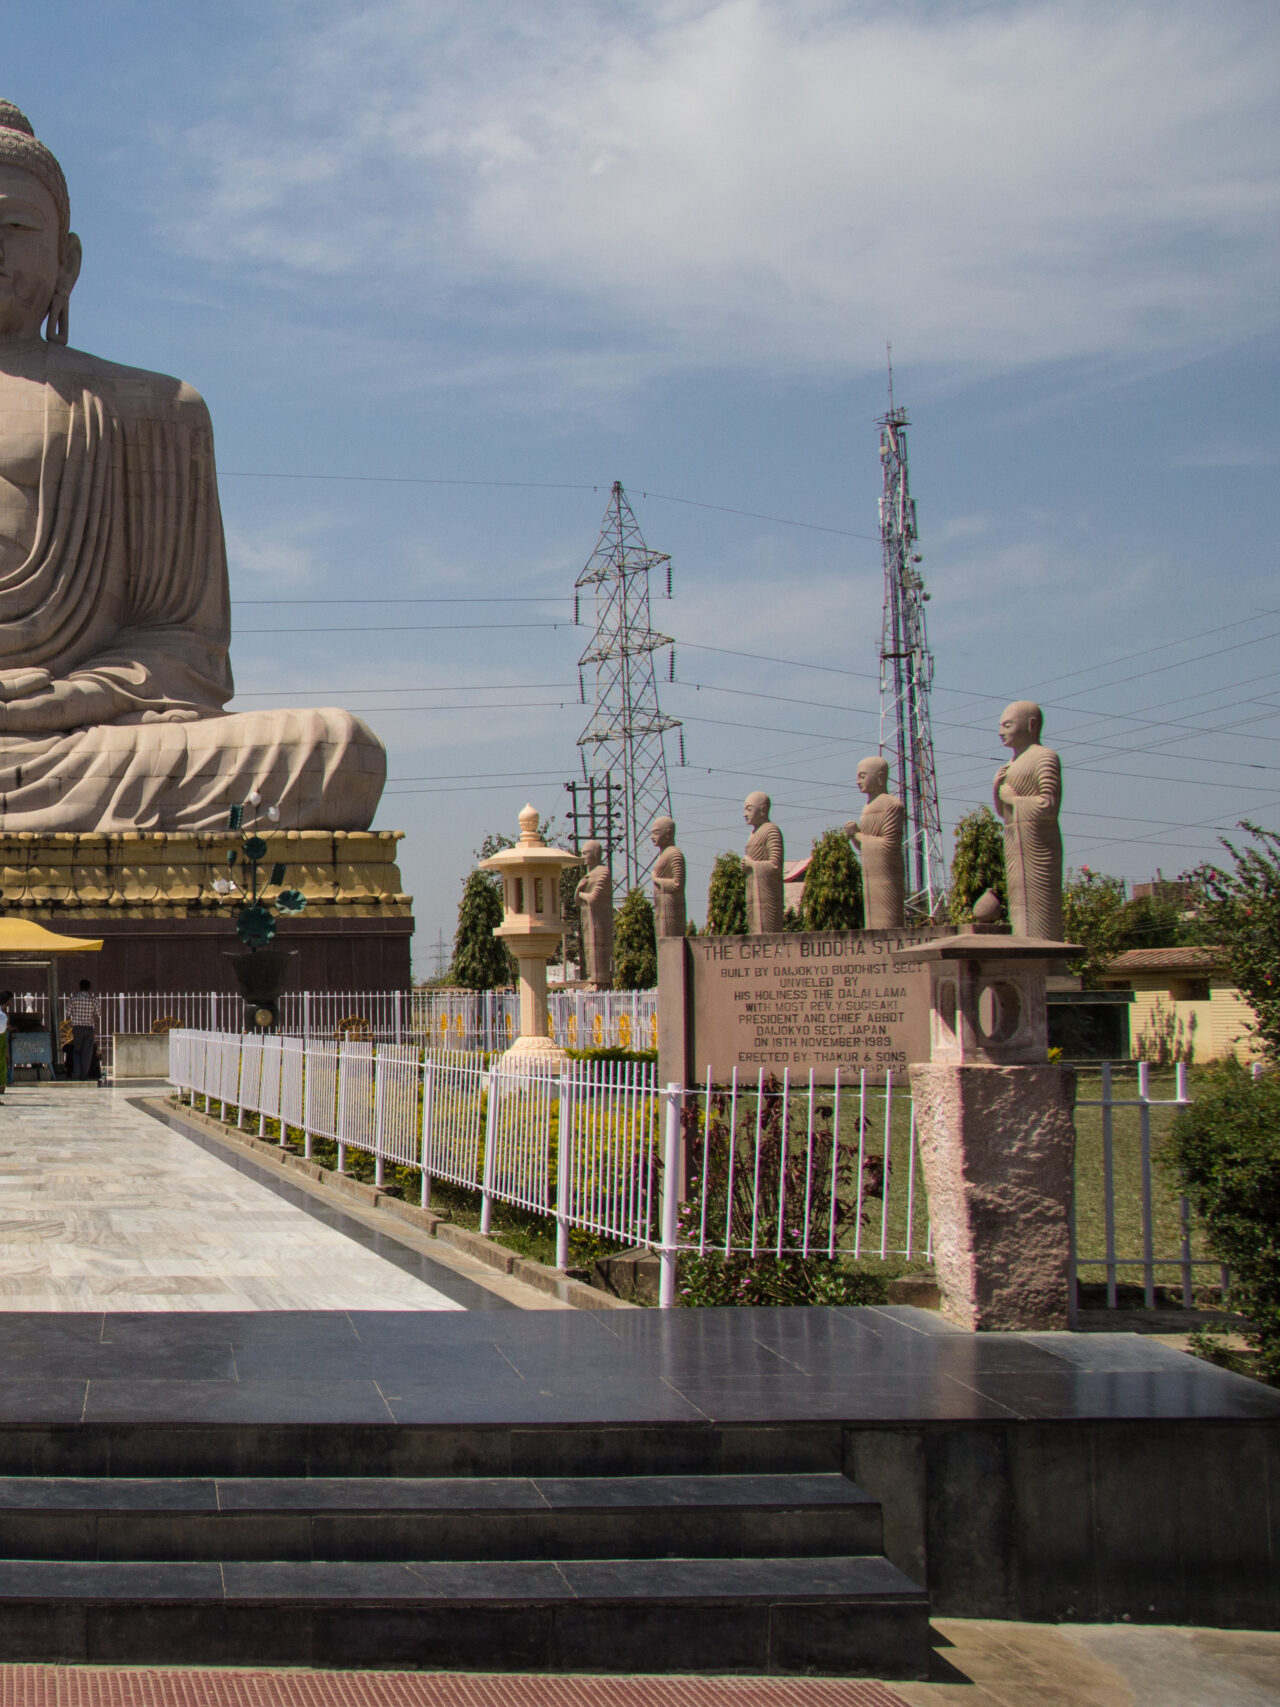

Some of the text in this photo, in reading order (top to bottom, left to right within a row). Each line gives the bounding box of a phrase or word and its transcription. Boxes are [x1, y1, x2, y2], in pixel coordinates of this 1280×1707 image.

[703, 937, 940, 961] THE GREAT BUDDHA STAT
[721, 962, 927, 977] BUILT BY DAIJOKYO BUDDHIST SECT.
[780, 977, 859, 987] UNVIELED BY
[734, 987, 906, 1000] HIS HOLINESS THE DALAI LAMA
[745, 1003, 771, 1012] WITH
[775, 1002, 805, 1012] MOST
[810, 1001, 834, 1011] REV.
[846, 1000, 898, 1011] SUGISAKI
[738, 1012, 904, 1024] PRESIDENT AND CHIEF ABBOT
[756, 1024, 887, 1036] DAIJOKYO SECT. JAPAN
[754, 1038, 768, 1048] ON
[738, 1051, 906, 1062] ERECTED BY: THAKUR & SONS
